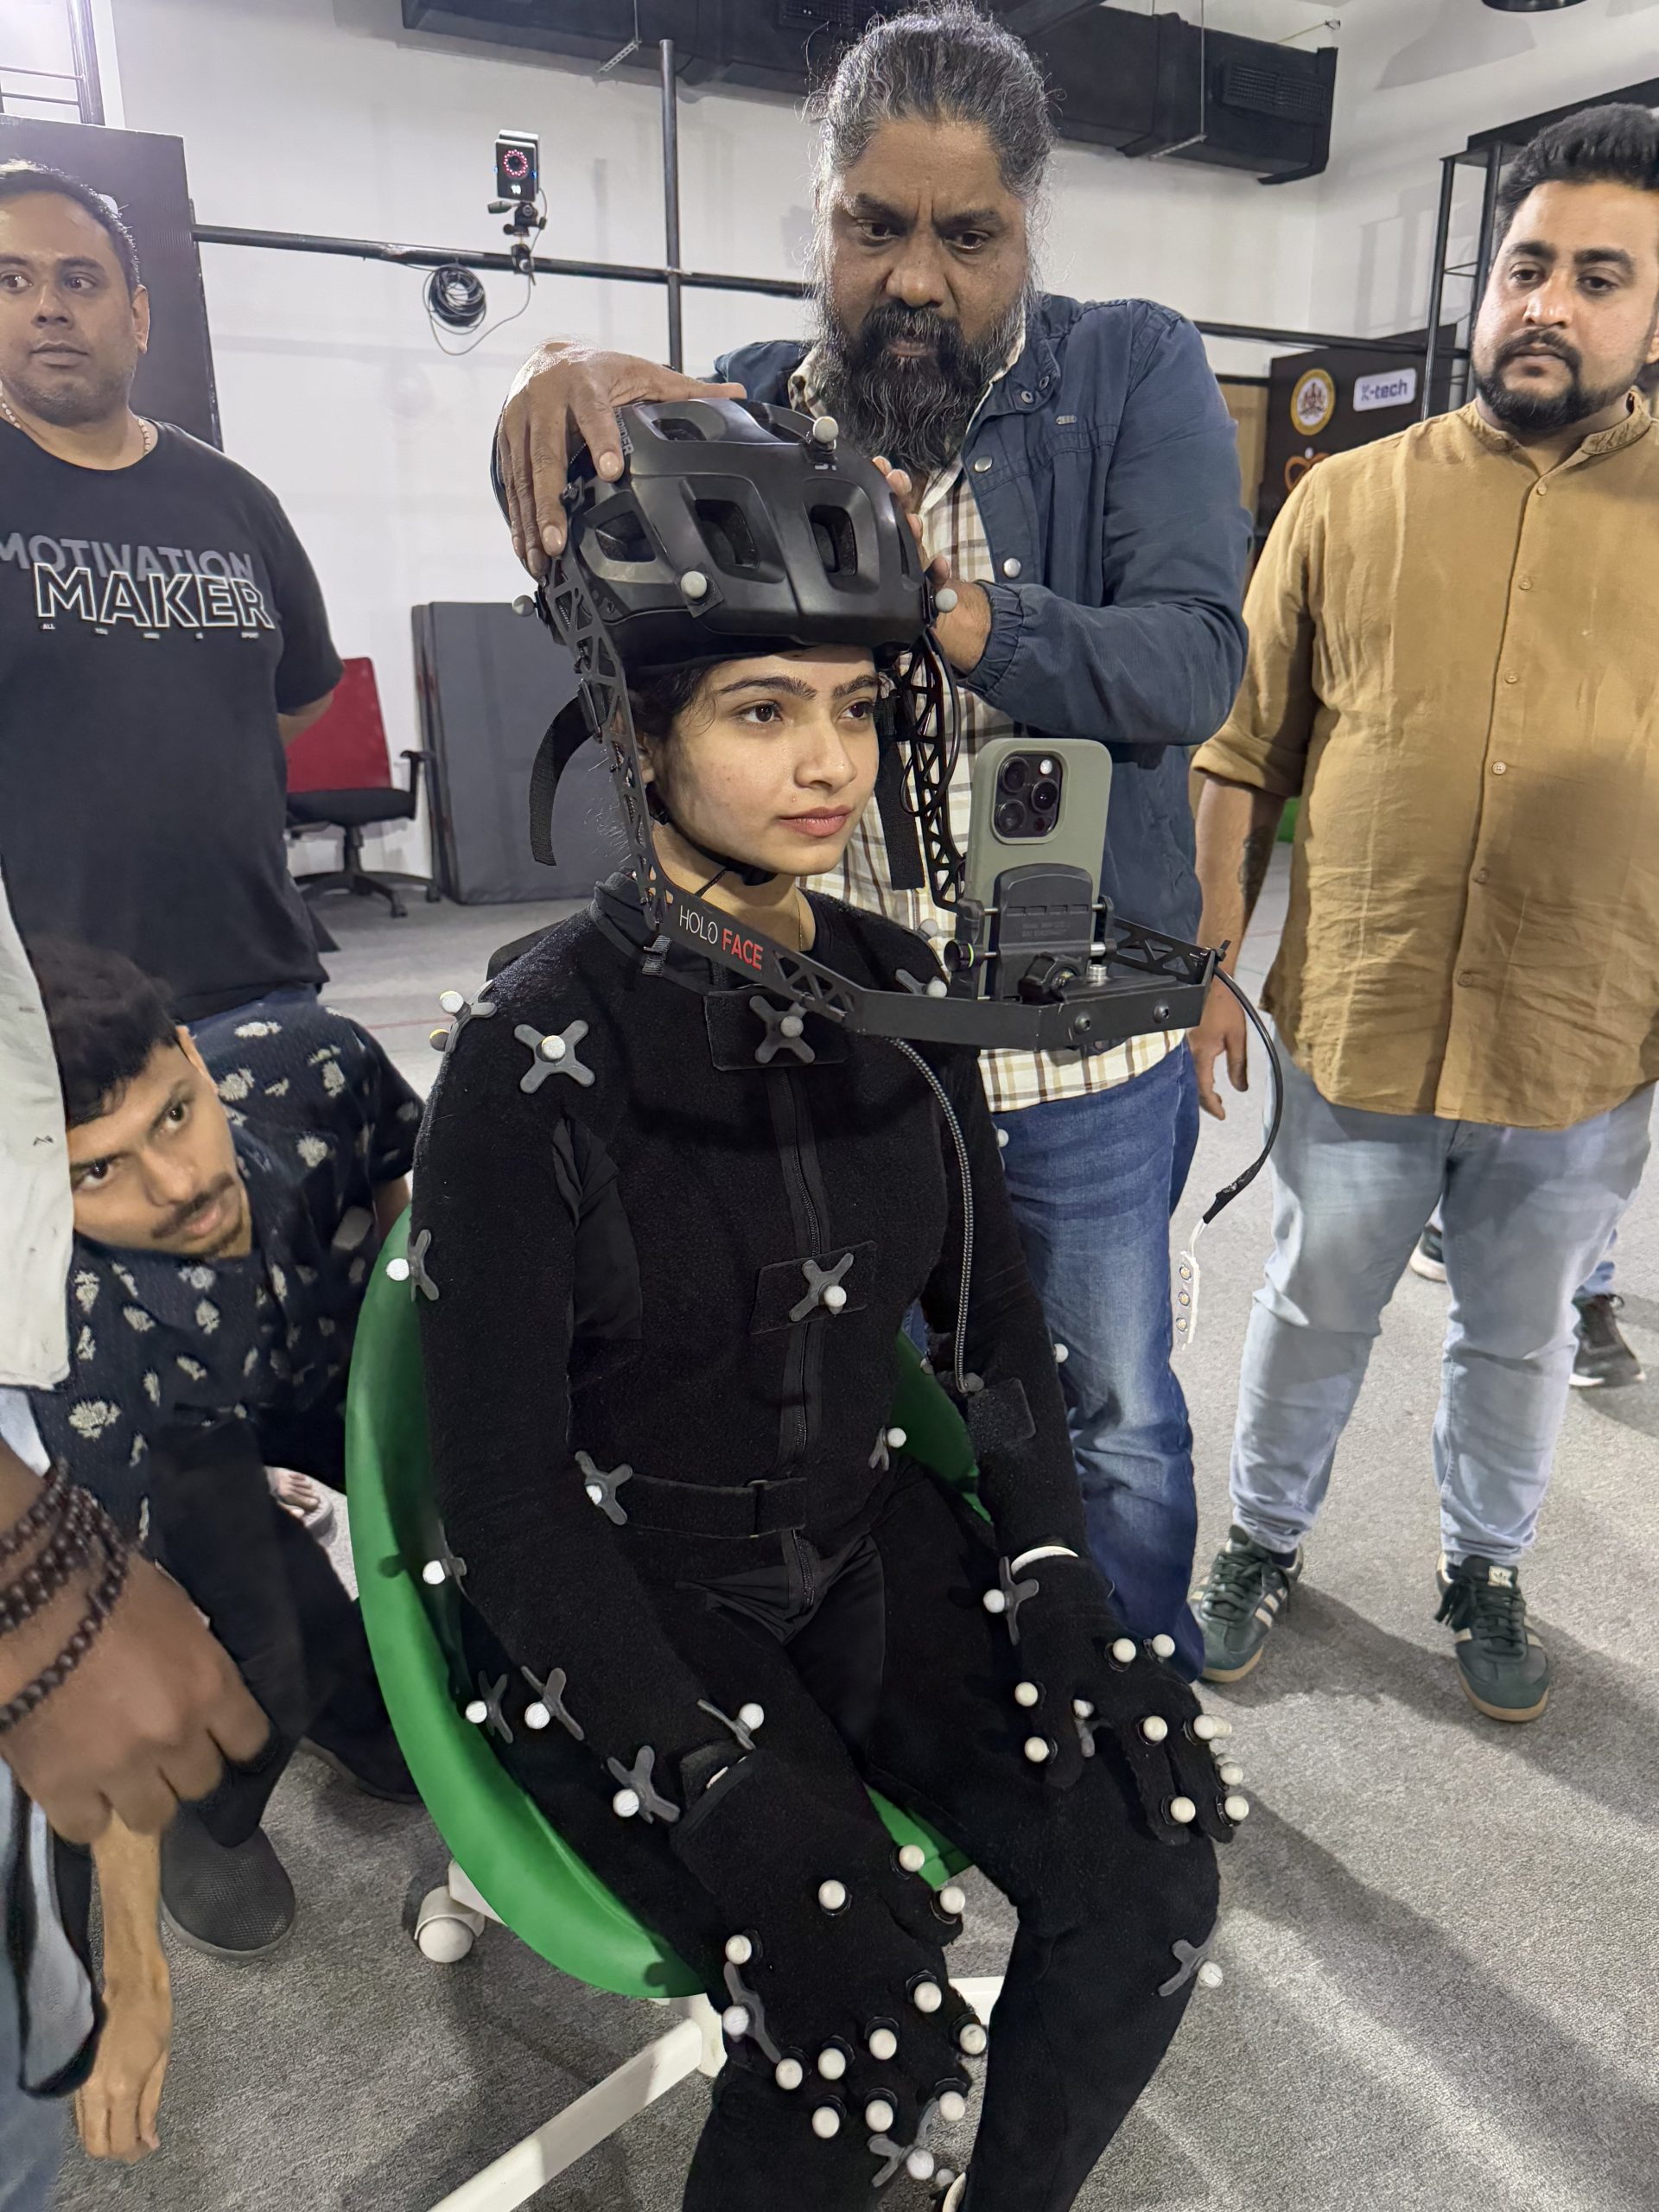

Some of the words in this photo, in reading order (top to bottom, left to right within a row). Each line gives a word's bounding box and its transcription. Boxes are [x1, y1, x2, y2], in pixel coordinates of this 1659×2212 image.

[1361, 378, 1408, 402] K-tech
[0, 532, 255, 582] MOTIVATION
[34, 562, 276, 629] MAKER
[679, 905, 718, 944] HOLO
[721, 928, 764, 970] FACE
